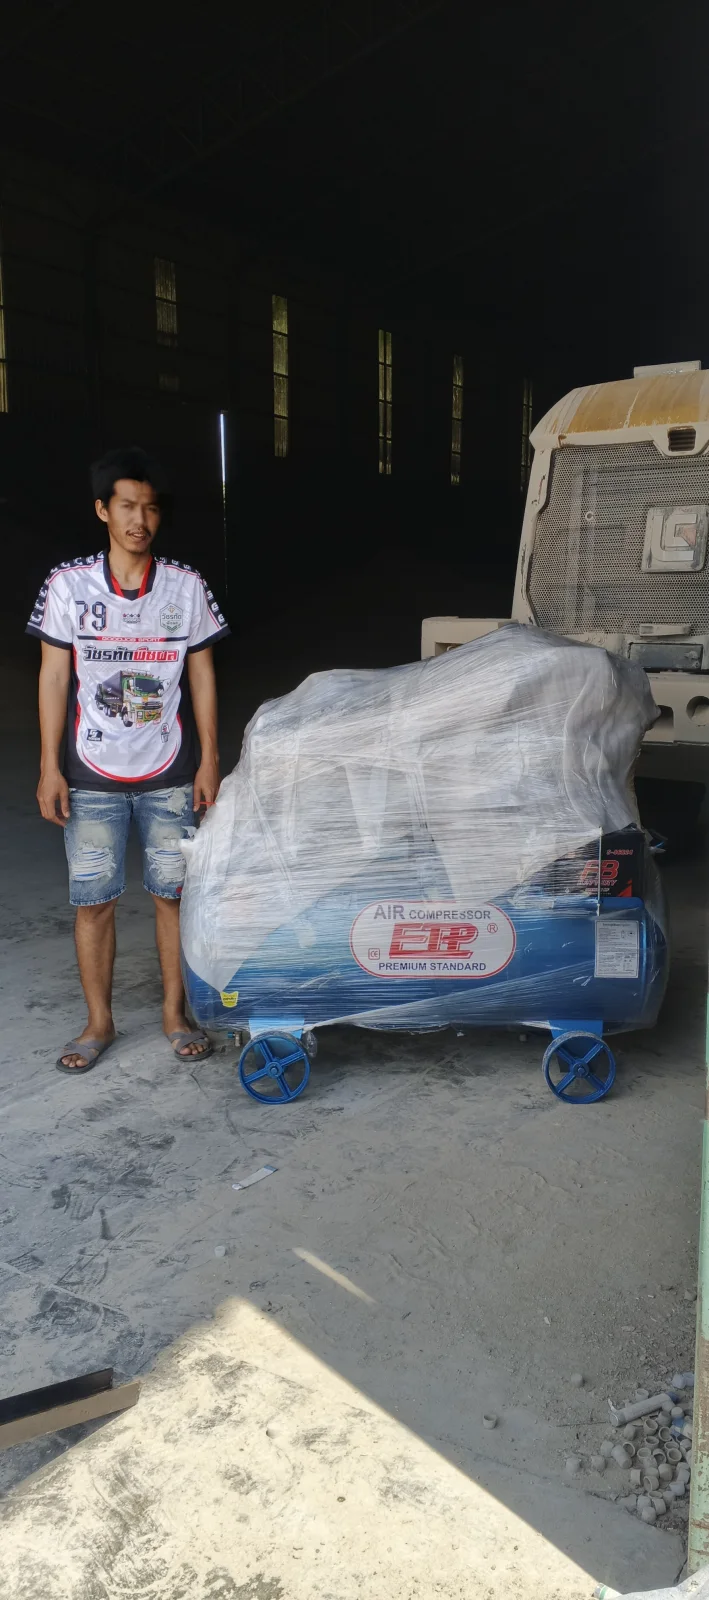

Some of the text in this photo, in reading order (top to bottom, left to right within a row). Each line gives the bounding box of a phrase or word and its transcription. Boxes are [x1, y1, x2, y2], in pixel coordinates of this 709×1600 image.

[75, 600, 107, 631] 79
[373, 904, 491, 920] AIR COMPRESSOR
[379, 962, 486, 971] PREMIUM STANDARD
